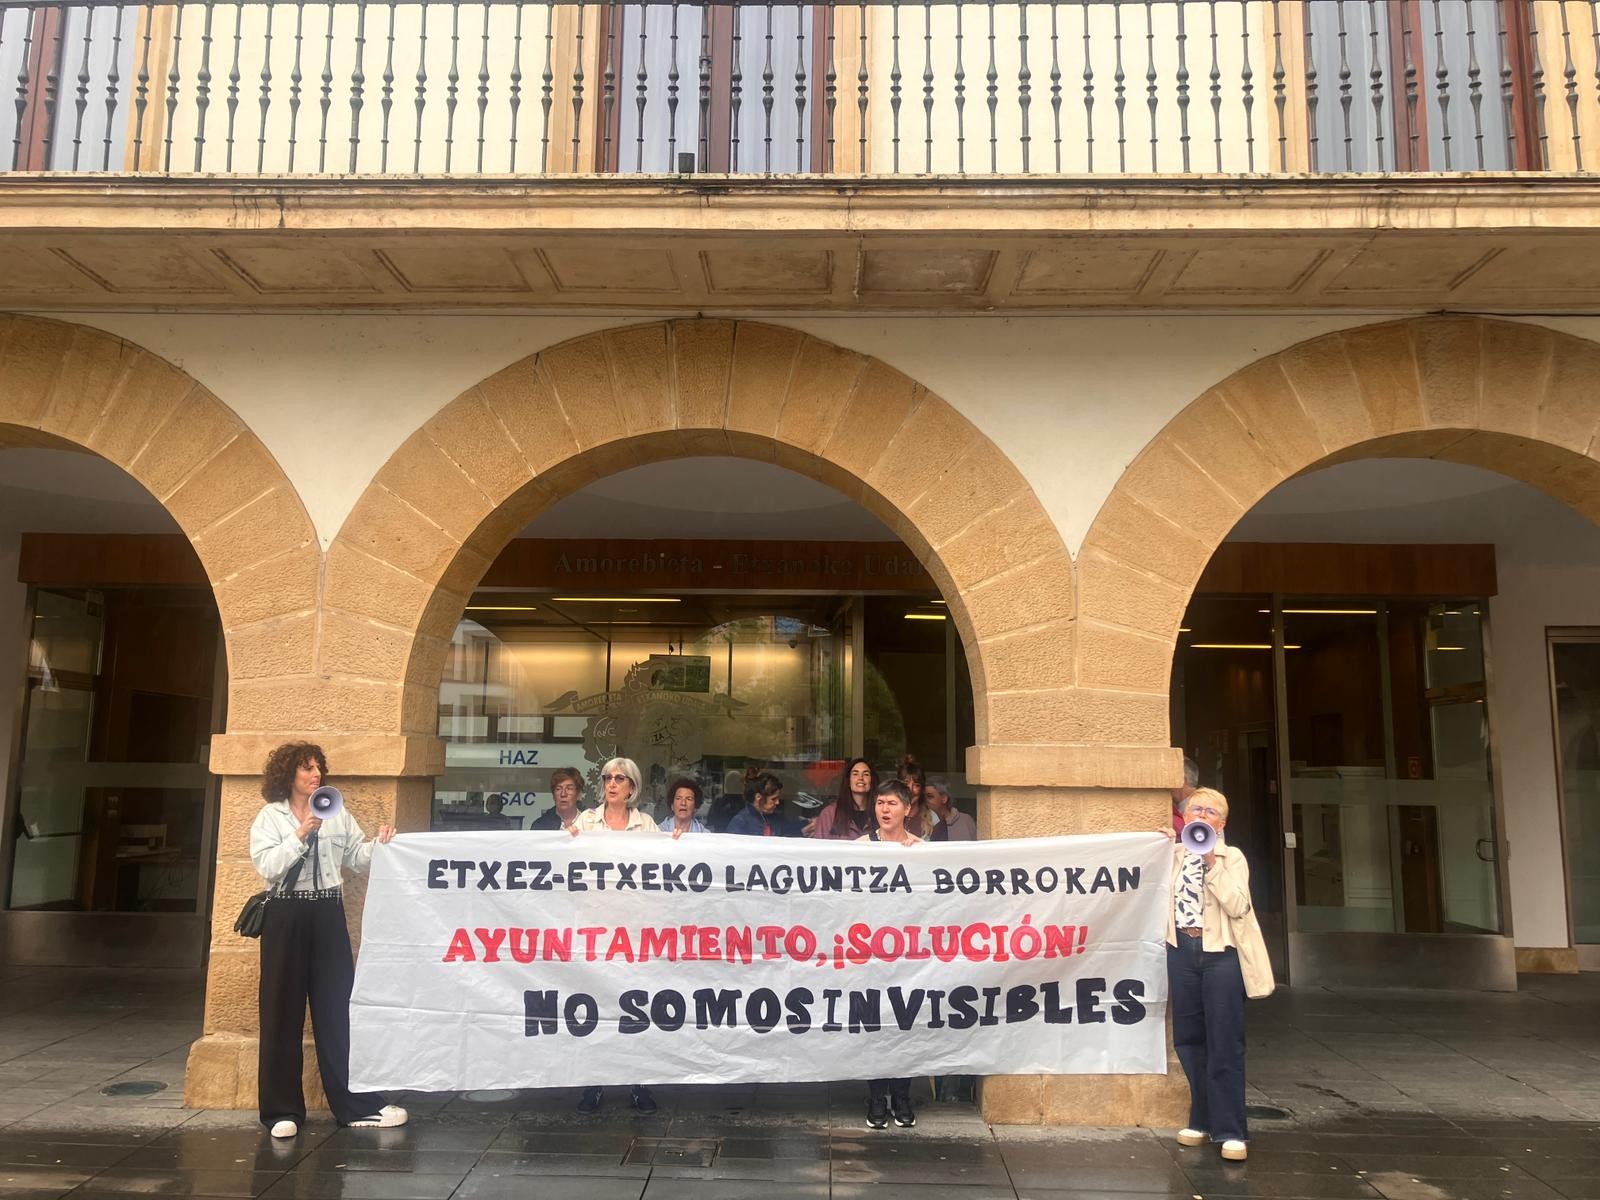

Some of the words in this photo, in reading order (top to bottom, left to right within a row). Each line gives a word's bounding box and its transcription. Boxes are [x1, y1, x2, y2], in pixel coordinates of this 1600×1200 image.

[499, 750, 538, 765] HAZ
[500, 792, 536, 806] SAC
[427, 859, 713, 893] ETXEZ-ETXEKO
[725, 863, 912, 895] LAGUNTZA
[932, 866, 1141, 896] BORROKAN
[524, 989, 599, 1037] NO
[618, 987, 814, 1035] SOMOS
[822, 977, 1146, 1034] INVISIBLES
